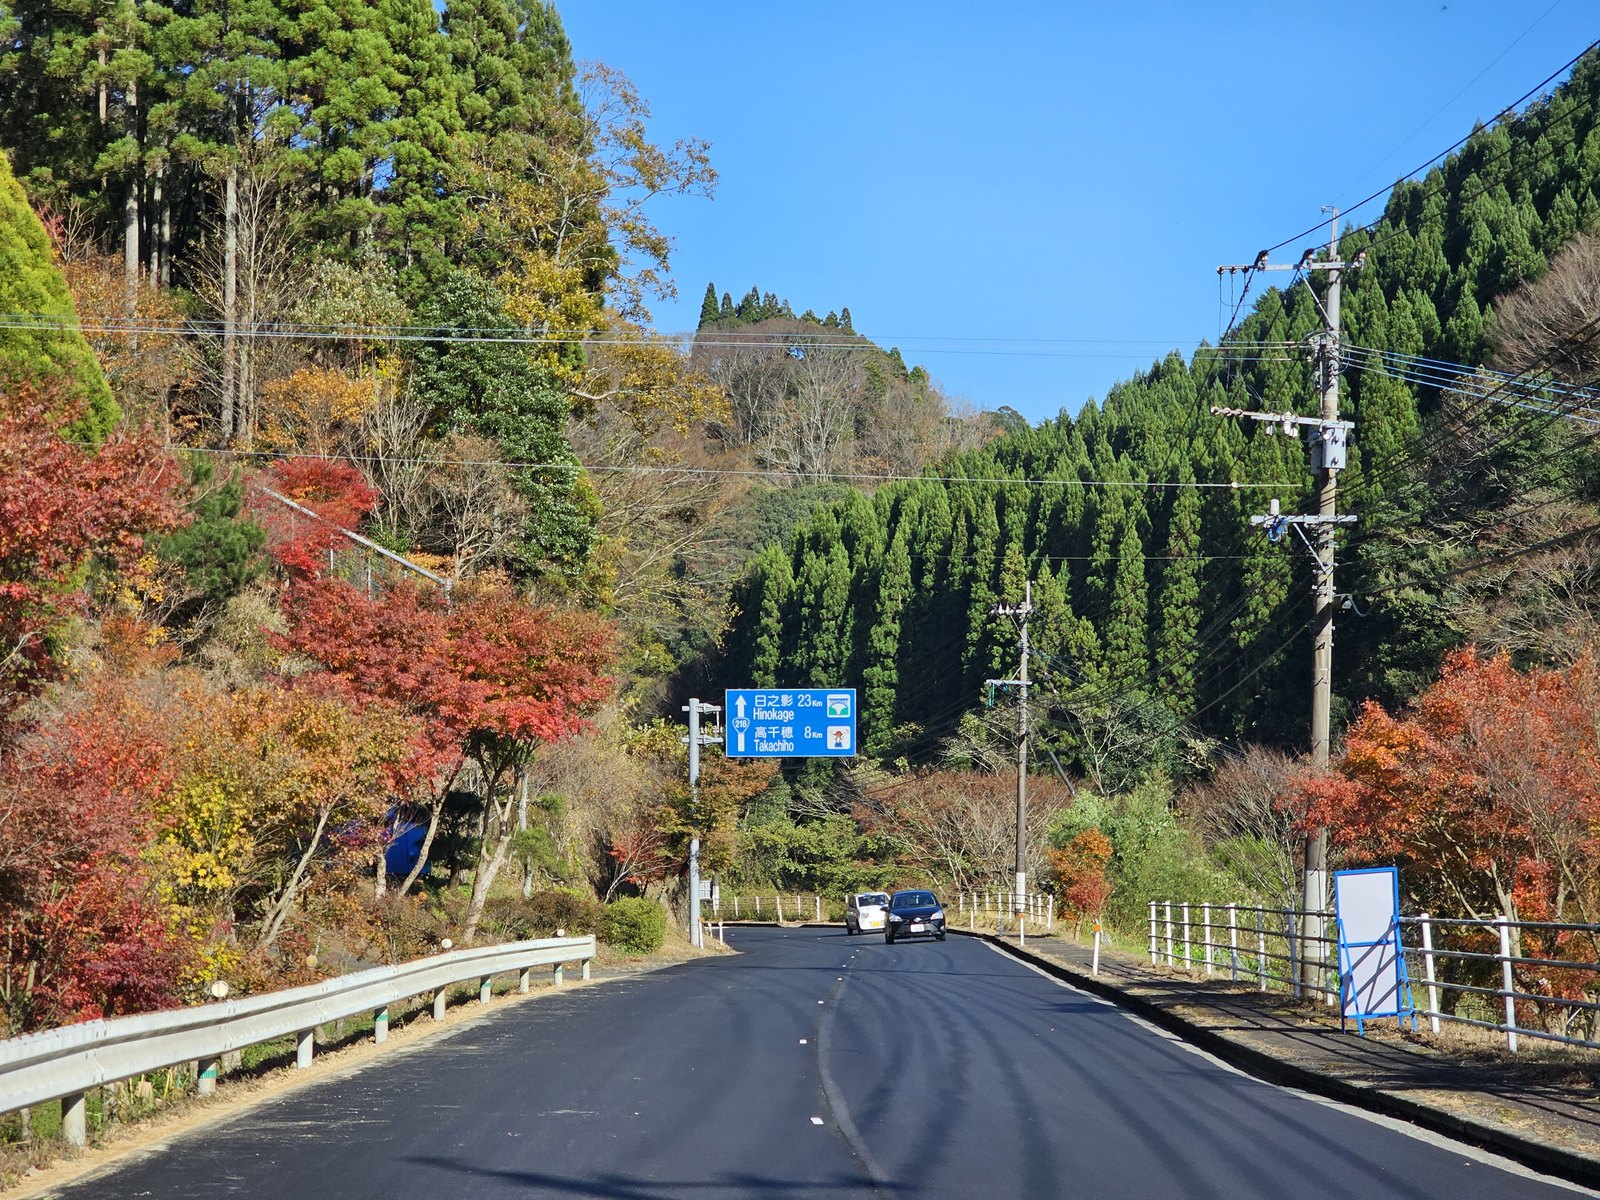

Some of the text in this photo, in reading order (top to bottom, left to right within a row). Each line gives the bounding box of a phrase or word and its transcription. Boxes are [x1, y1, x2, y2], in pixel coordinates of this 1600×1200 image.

[755, 694, 793, 707] 日之影
[754, 708, 794, 722] Hinokage
[735, 720, 748, 728] 218
[754, 726, 794, 738] 高千穂
[754, 740, 794, 752] Takachiho
